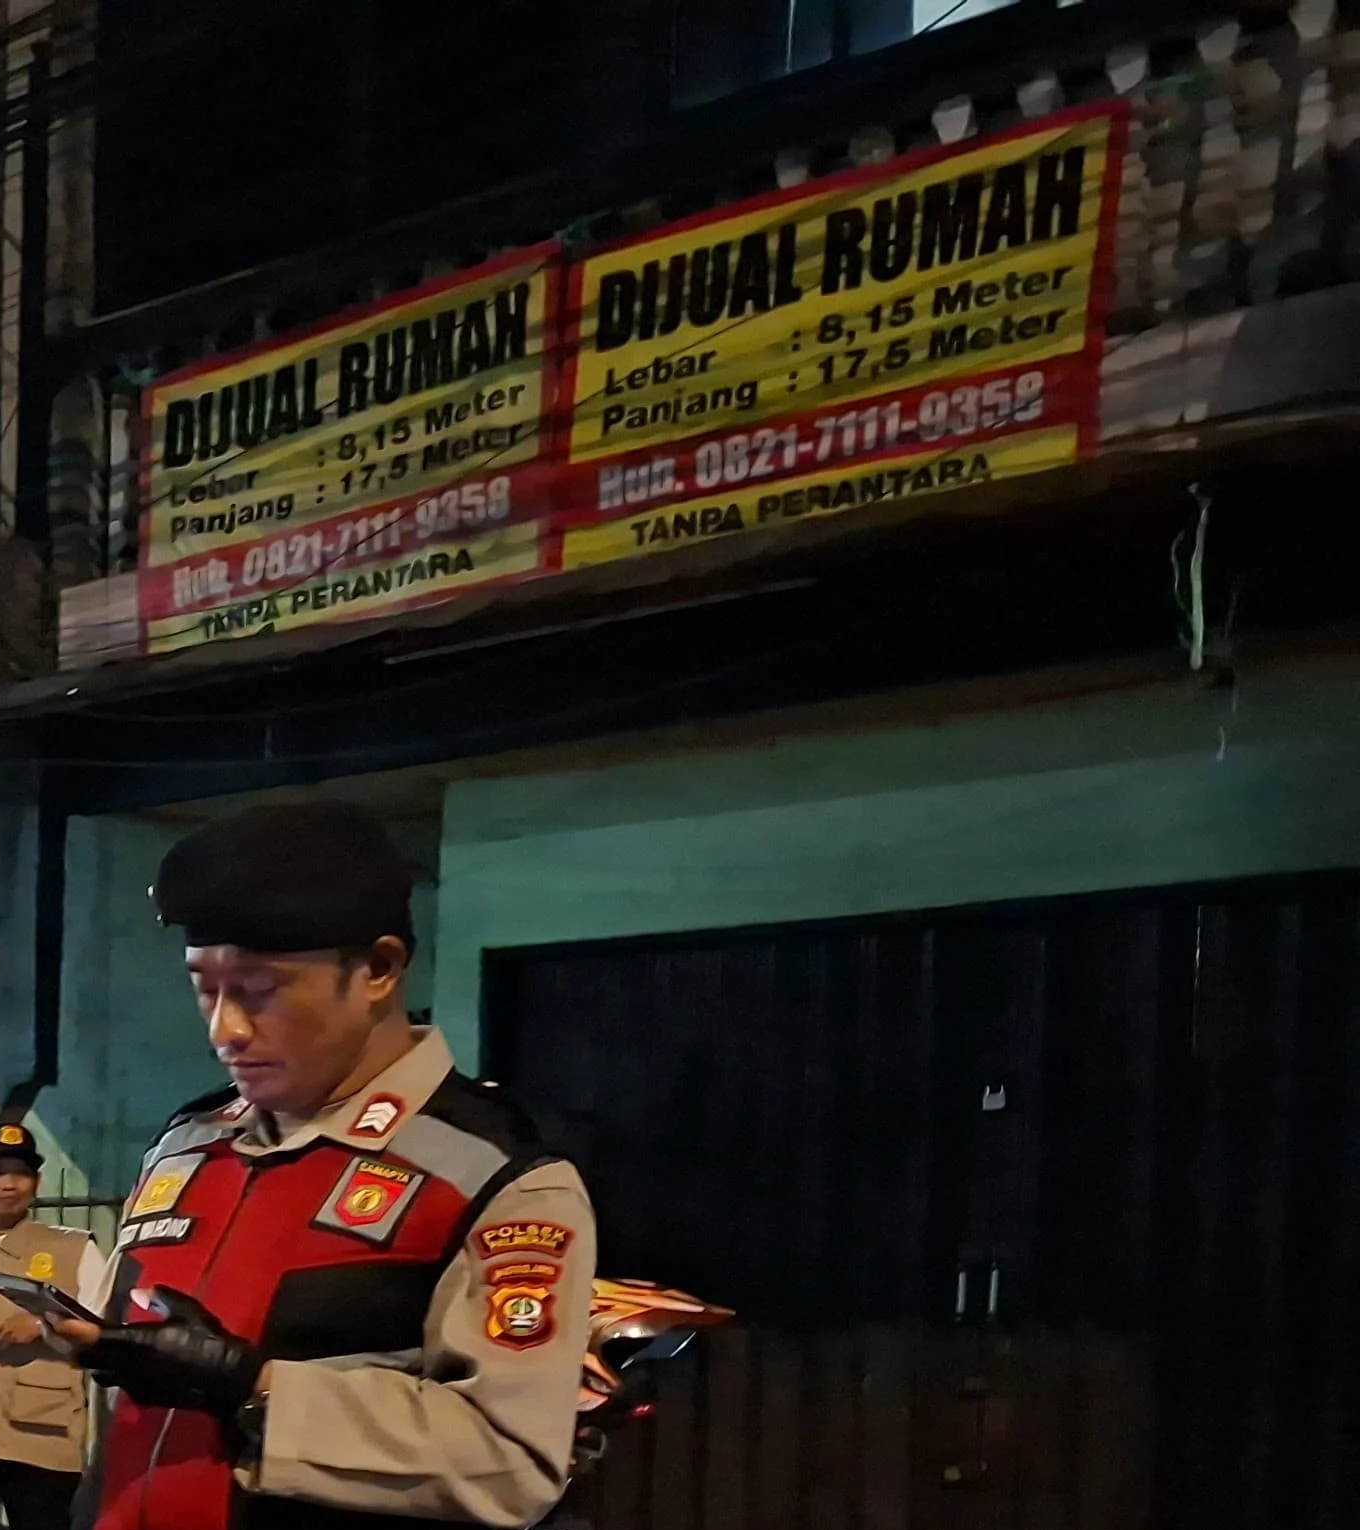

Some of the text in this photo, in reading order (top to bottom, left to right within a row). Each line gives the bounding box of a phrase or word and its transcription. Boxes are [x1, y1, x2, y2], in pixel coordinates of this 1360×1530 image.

[595, 146, 1087, 353] DIJUAL RUMAH
[163, 282, 529, 469] DIJUAL RUMAH
[602, 378, 759, 435] Panjang
[818, 339, 911, 386] 17,5
[928, 307, 1068, 362] Meter
[605, 347, 716, 396] Lebar
[817, 295, 914, 346] 8,15
[931, 265, 1074, 317] Meter
[170, 492, 294, 542] Panjang
[340, 453, 408, 495] 17,5
[422, 423, 523, 471] Meter
[337, 416, 411, 462] 8,15
[424, 383, 525, 435] Meter
[630, 452, 992, 546] TANPA PERANTARA
[200, 548, 475, 640] TANPA PERANTARA
